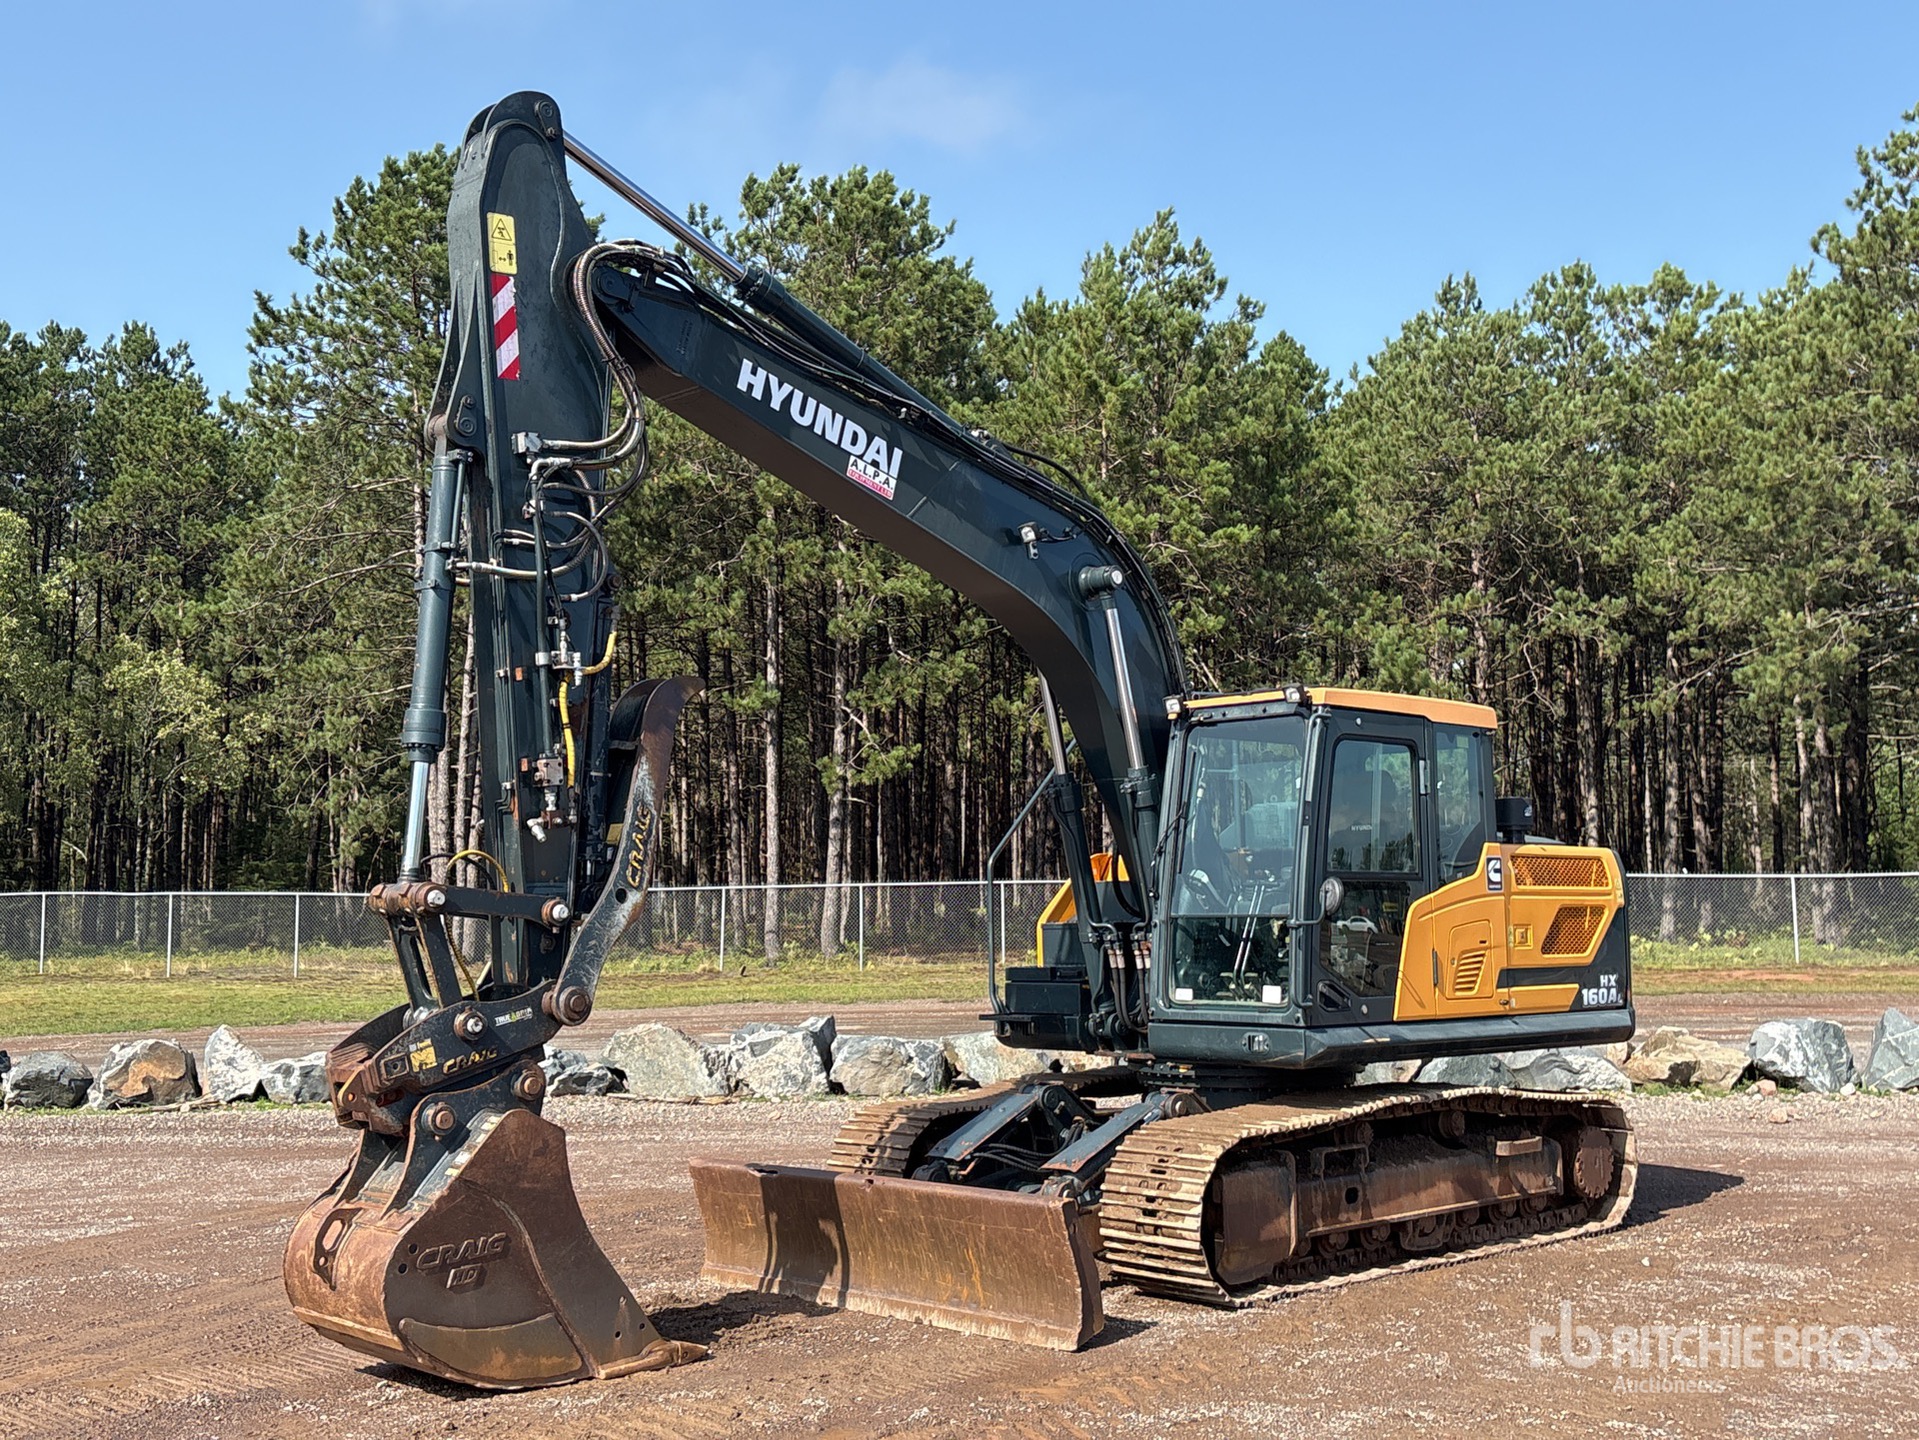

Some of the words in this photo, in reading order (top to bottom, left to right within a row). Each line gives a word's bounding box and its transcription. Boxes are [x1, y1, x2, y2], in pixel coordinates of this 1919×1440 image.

[737, 358, 903, 478] HYUNDAI
[850, 459, 894, 491] A.L.P.A.
[626, 801, 651, 888] CRAIG
[1600, 974, 1617, 987] HX
[442, 1047, 498, 1074] CRAIG
[416, 1232, 508, 1269] CRAIG
[446, 1263, 483, 1289] HD
